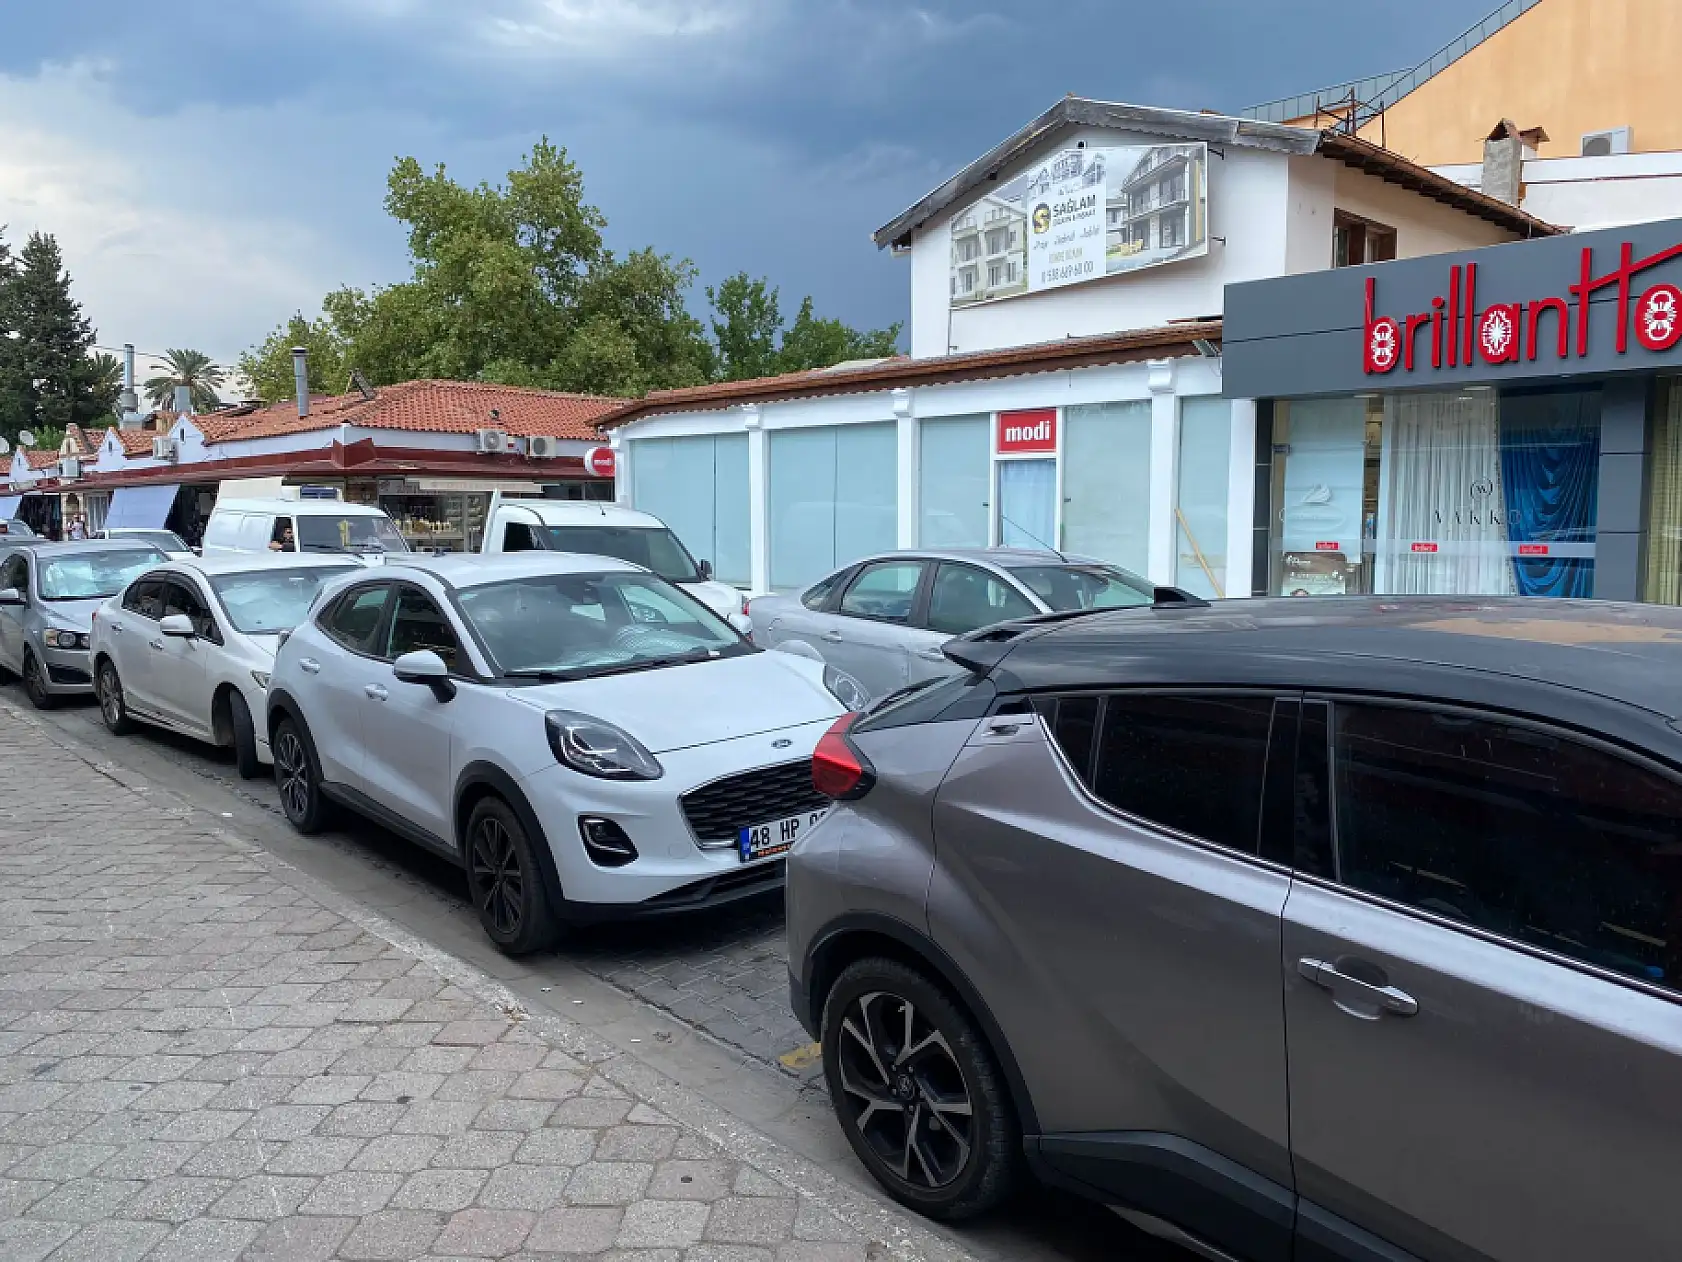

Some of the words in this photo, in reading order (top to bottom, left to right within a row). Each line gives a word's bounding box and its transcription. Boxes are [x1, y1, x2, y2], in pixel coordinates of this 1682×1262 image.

[1052, 194, 1096, 218] SAĞLAM
[1005, 420, 1051, 442] modi
[750, 827, 769, 848] 48
[780, 818, 799, 842] HP
